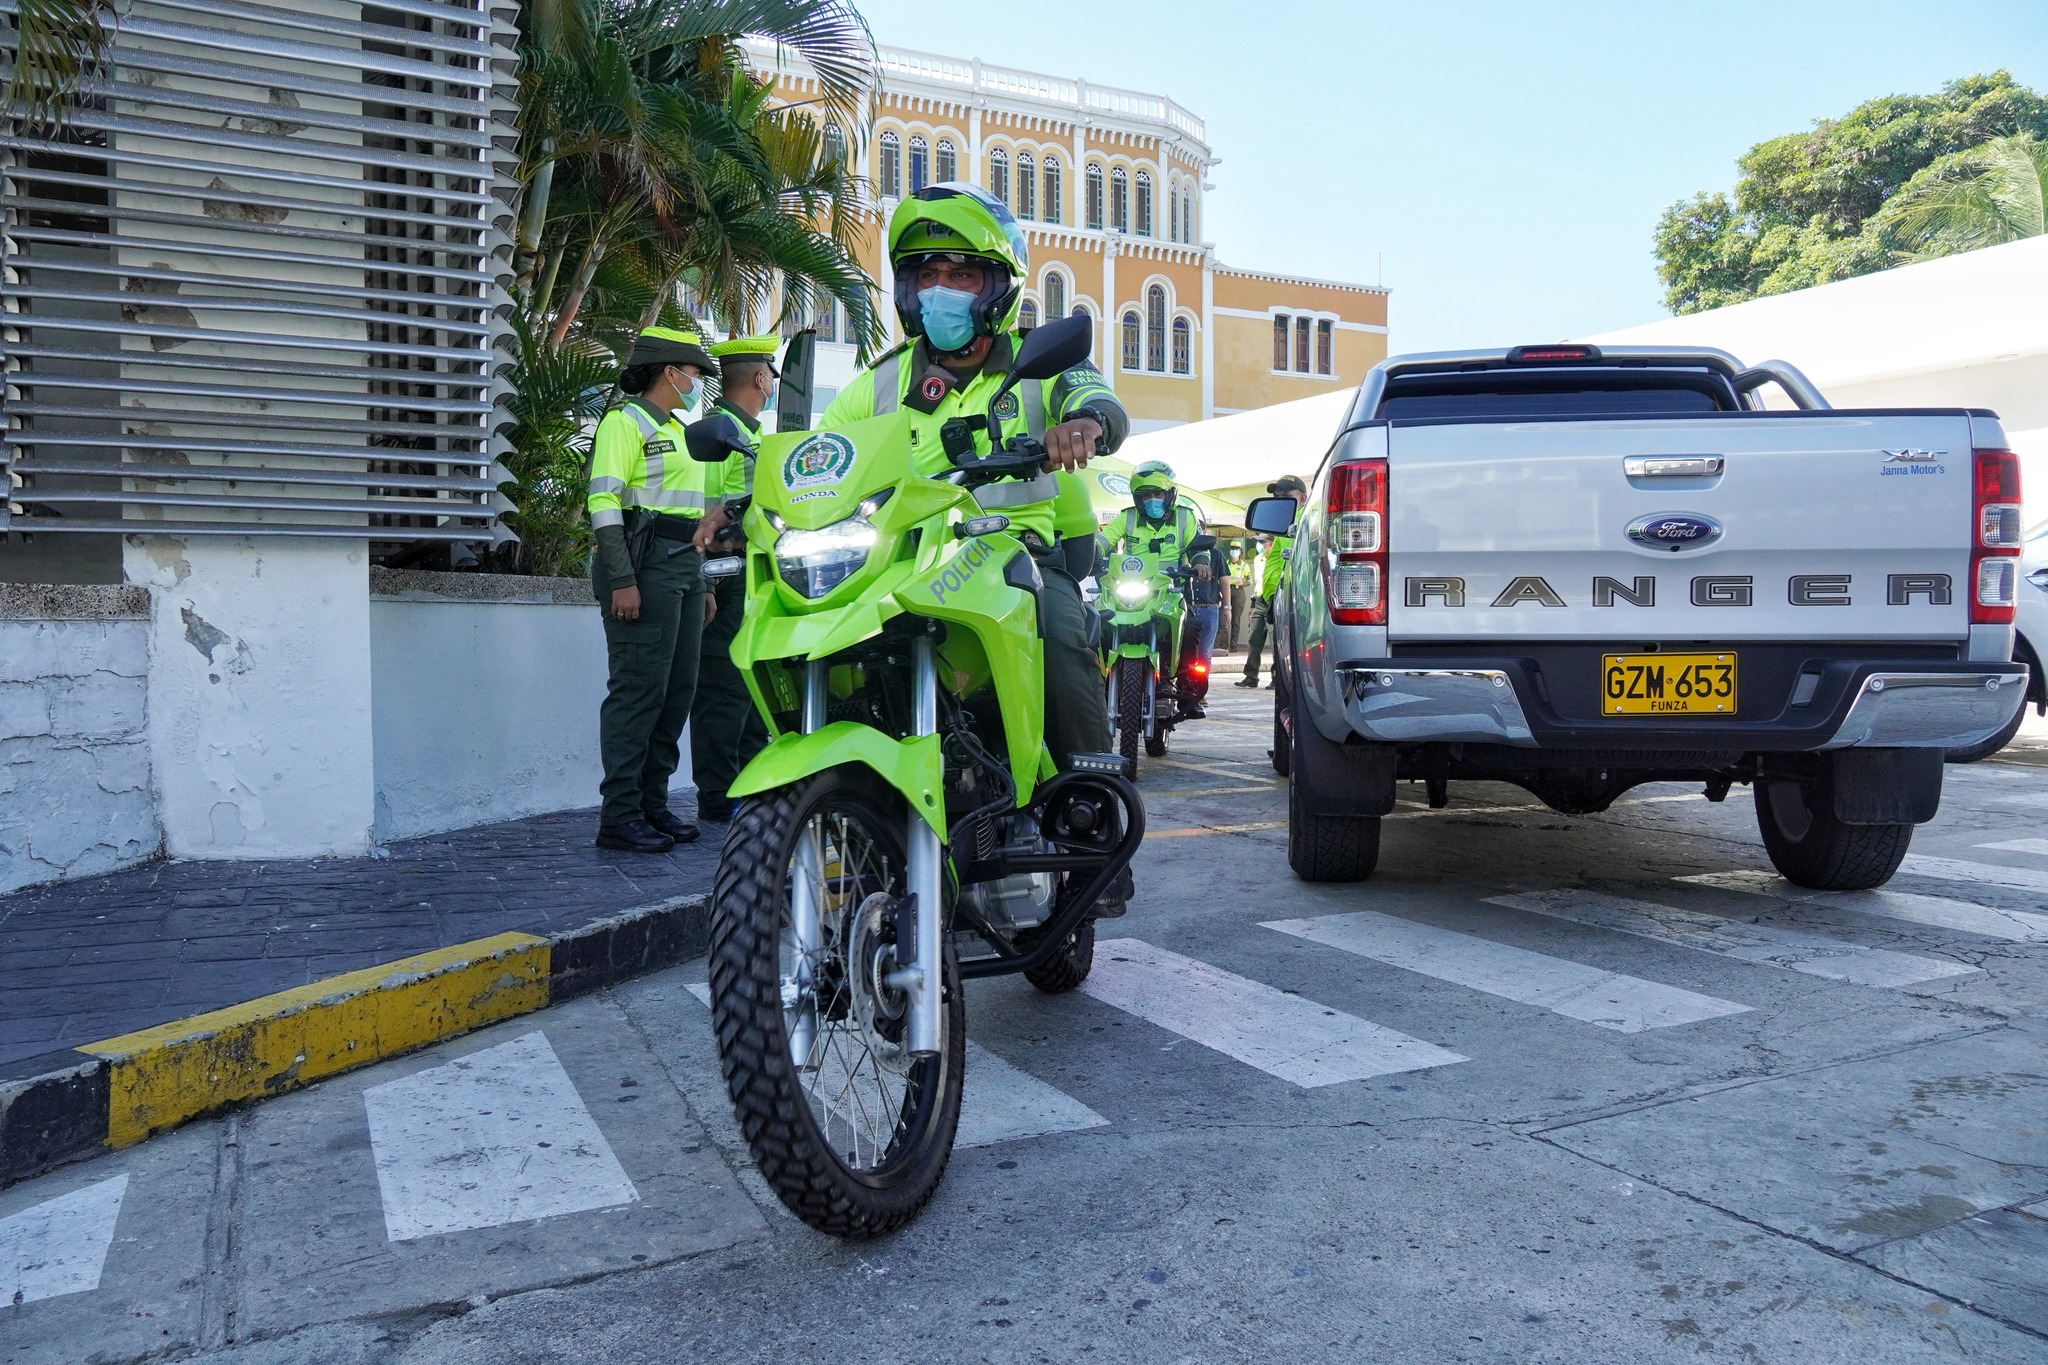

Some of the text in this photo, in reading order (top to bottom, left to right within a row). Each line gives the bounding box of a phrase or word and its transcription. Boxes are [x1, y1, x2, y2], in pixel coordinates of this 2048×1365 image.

[1881, 464, 1945, 475] Janna Motor's
[791, 490, 837, 503] HONDA
[1658, 522, 1697, 538] Ford
[929, 538, 996, 605] POLICIA
[1404, 573, 1953, 608] RANGER
[1607, 665, 1732, 699] GZM 653
[1651, 700, 1688, 711] FUNZA
